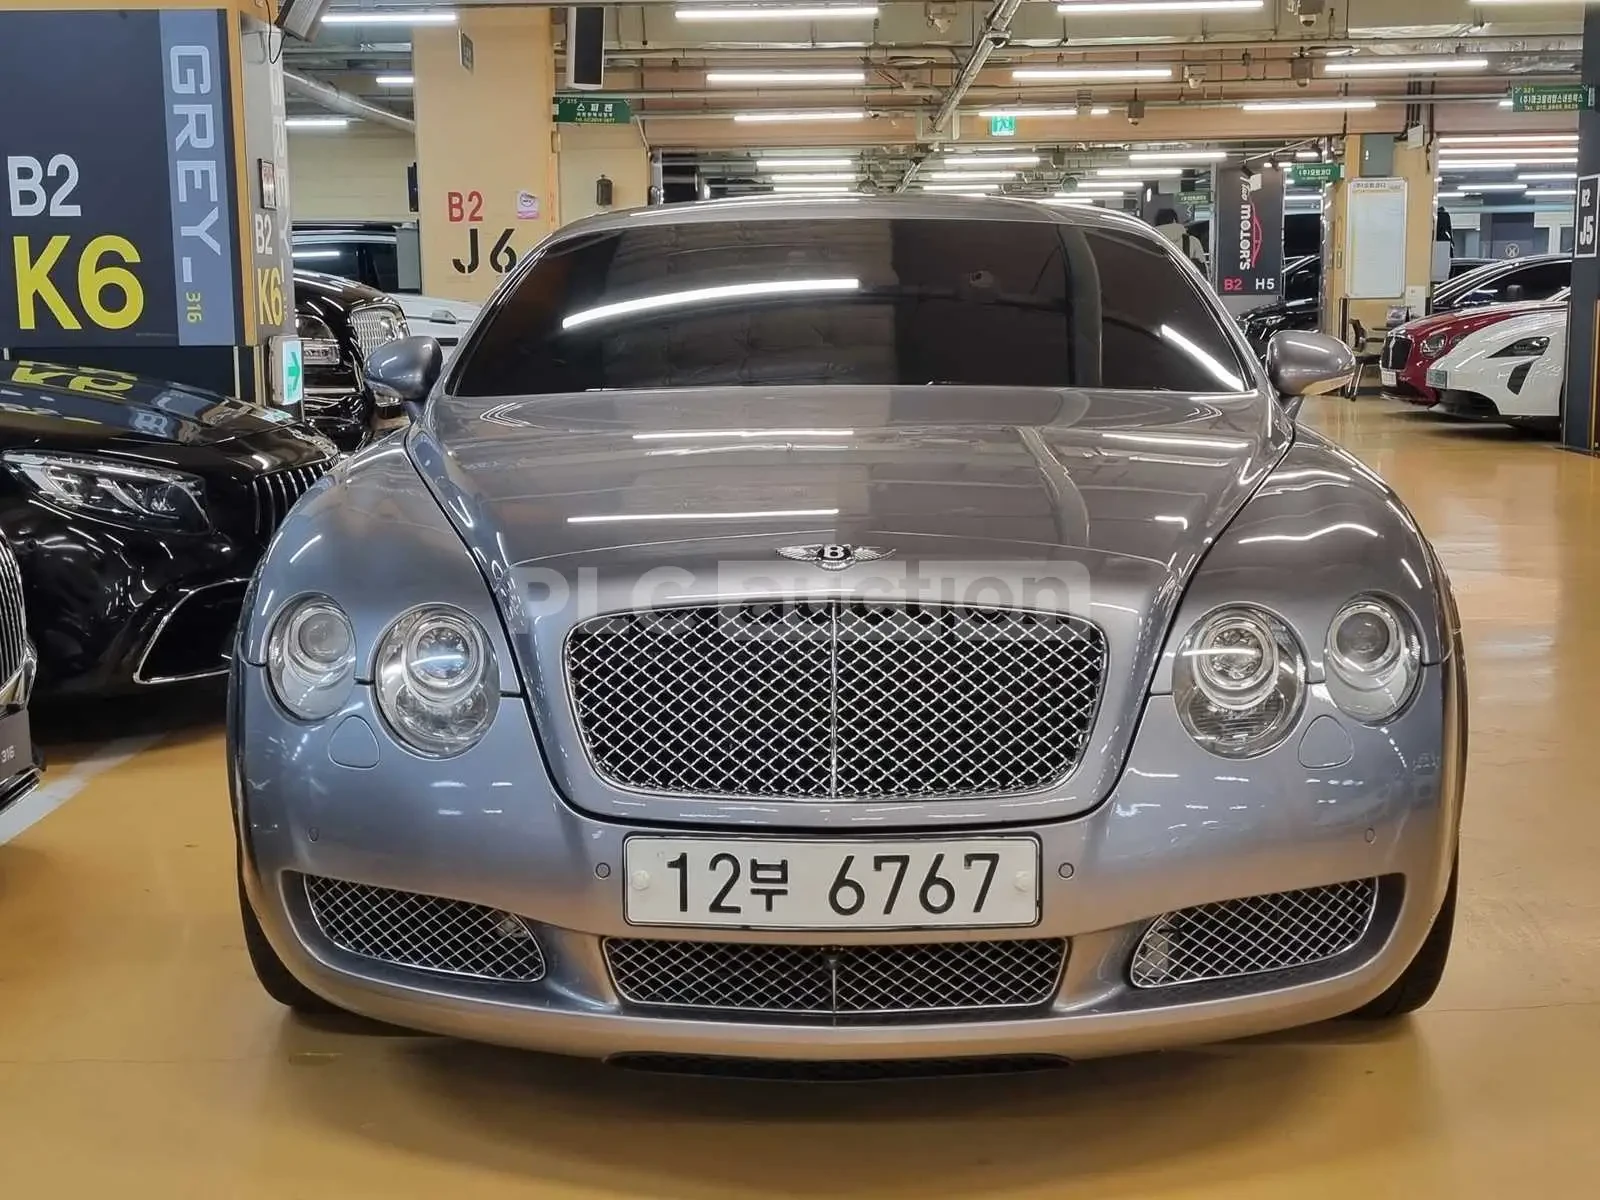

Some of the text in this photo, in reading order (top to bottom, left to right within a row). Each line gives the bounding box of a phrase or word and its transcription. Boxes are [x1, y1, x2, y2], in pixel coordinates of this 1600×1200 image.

[7, 153, 82, 217] B2
[447, 191, 483, 222] B2
[255, 213, 273, 256] B2
[452, 228, 517, 274] J6
[1580, 215, 1594, 245] J5
[13, 234, 144, 330] K6
[257, 267, 283, 326] K6
[1224, 278, 1275, 291] B2 H5
[185, 291, 203, 323] 316
[1, 745, 15, 763] 316
[666, 852, 1000, 915] 12부 6767
